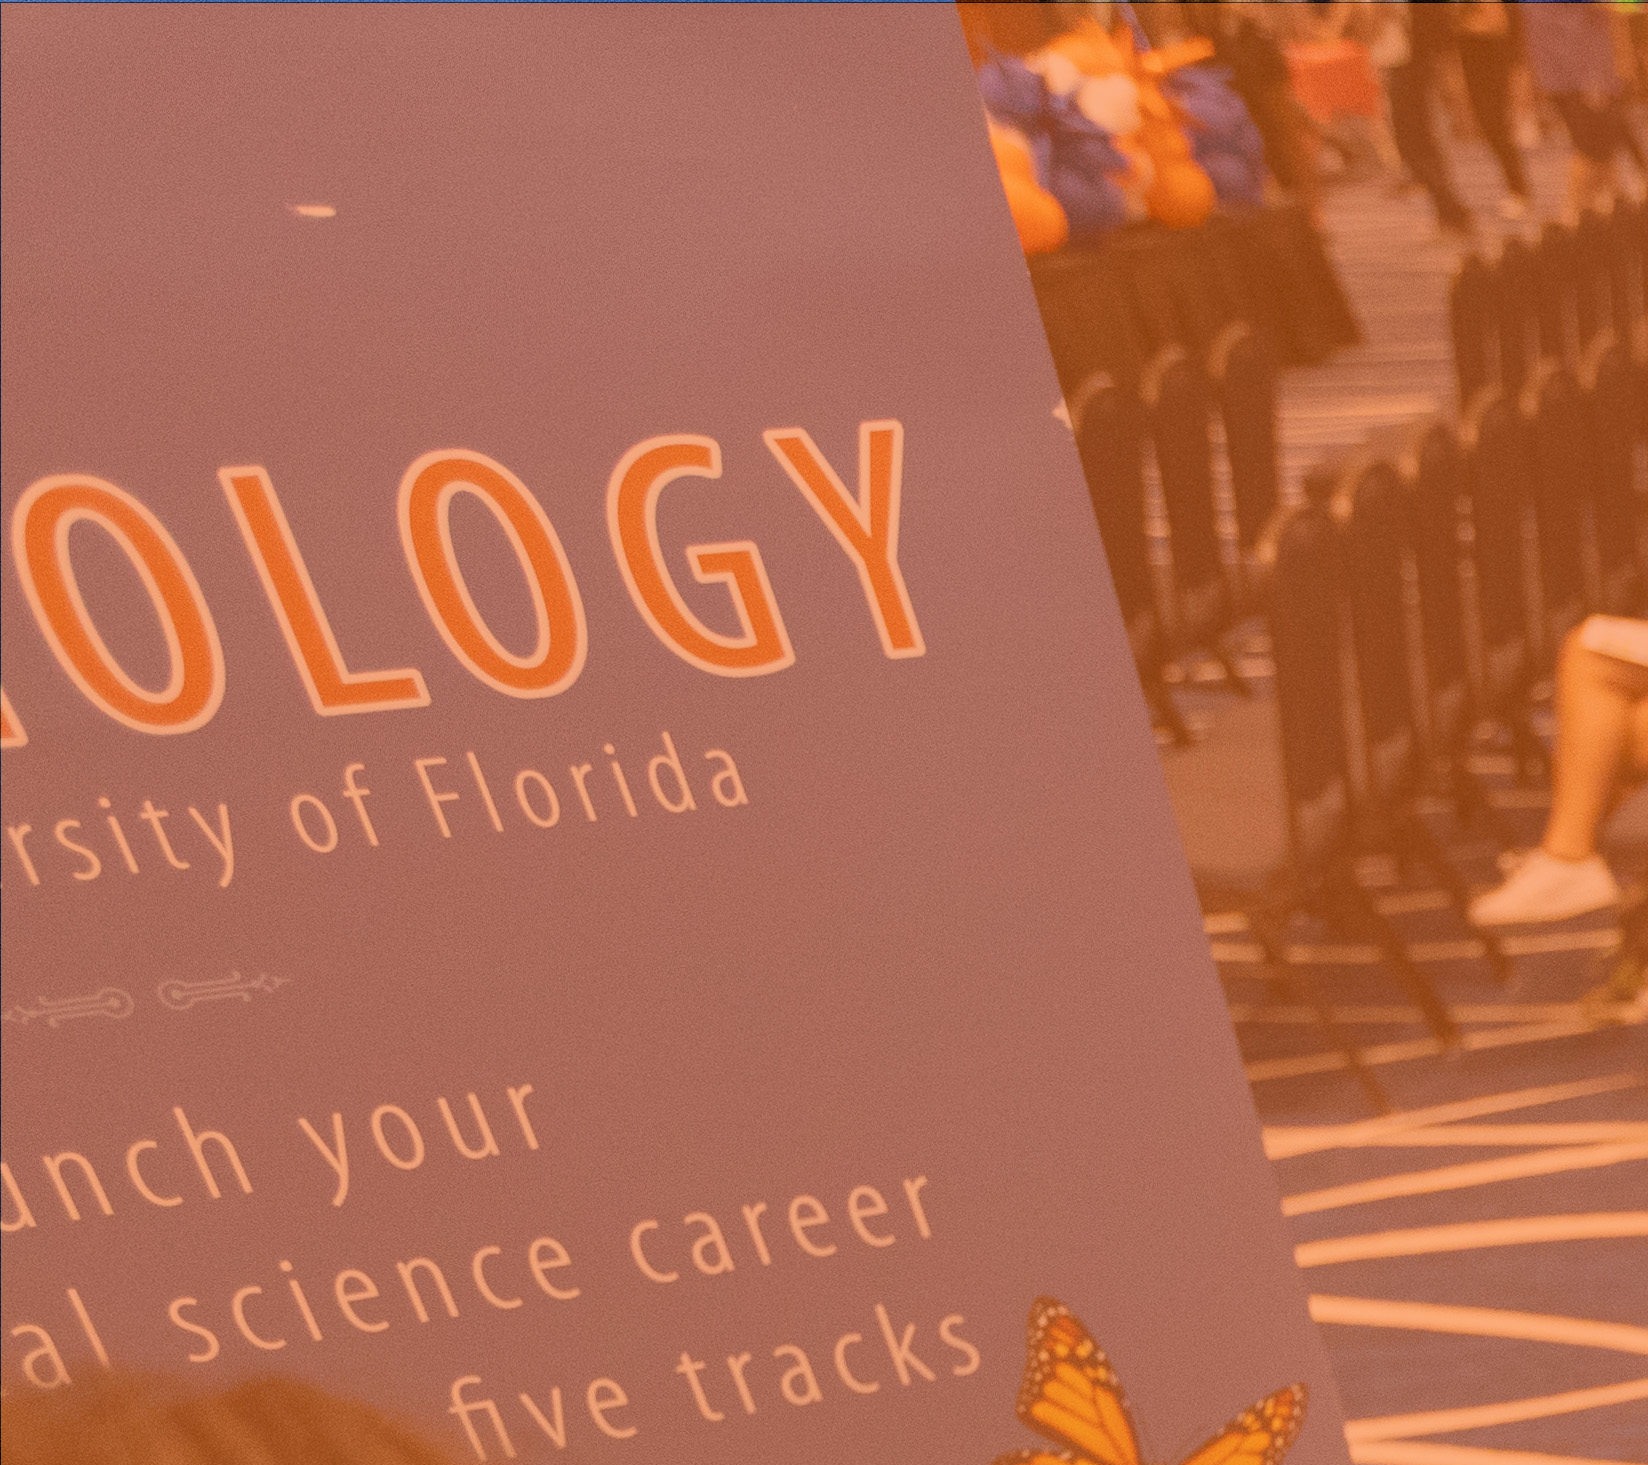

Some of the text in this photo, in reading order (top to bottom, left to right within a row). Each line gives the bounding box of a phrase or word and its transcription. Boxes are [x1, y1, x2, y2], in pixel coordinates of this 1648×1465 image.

[3, 420, 927, 746] OLOGY
[7, 731, 751, 889] rsity of Florida
[298, 1082, 545, 1206] your
[9, 1172, 939, 1392] al science career
[448, 1301, 984, 1464] five tracks
